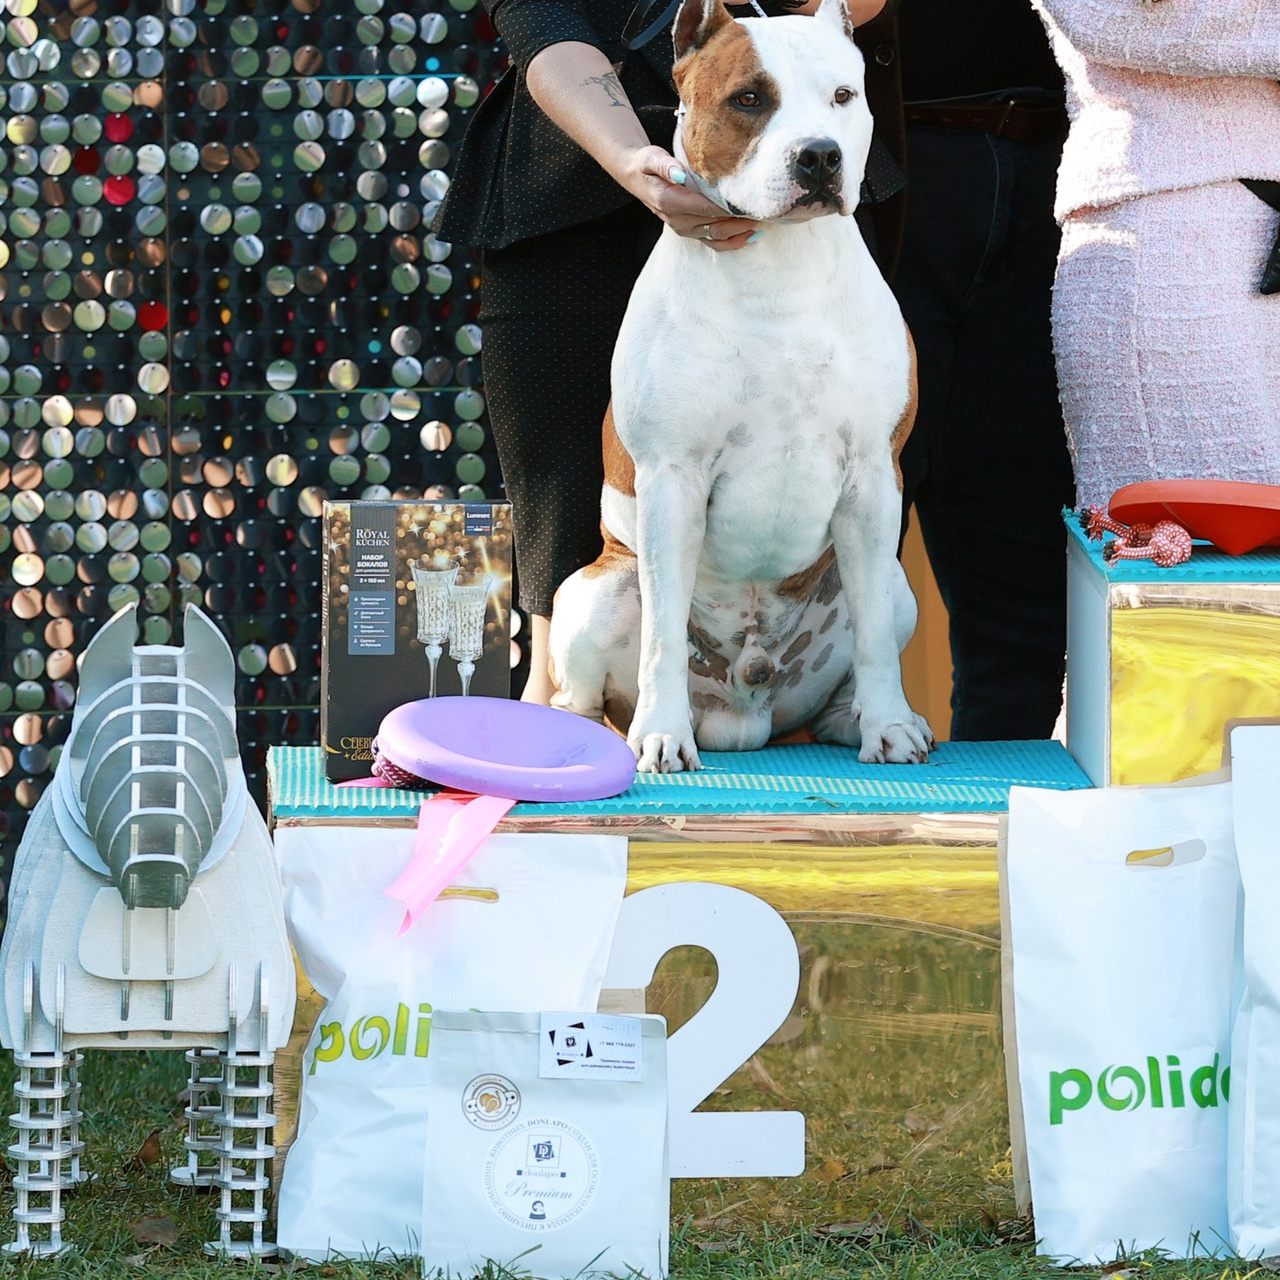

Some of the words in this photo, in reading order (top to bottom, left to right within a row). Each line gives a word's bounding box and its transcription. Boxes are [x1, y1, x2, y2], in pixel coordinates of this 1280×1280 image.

[356, 528, 390, 539] ROYAL
[356, 538, 390, 547] KÜCHEN
[600, 882, 805, 1177] 2
[309, 1002, 433, 1075] poli
[1049, 1052, 1231, 1125] polid
[527, 1118, 568, 1130] DONLAPO
[524, 1169, 559, 1180] donlapo
[504, 1179, 573, 1200] Premium
